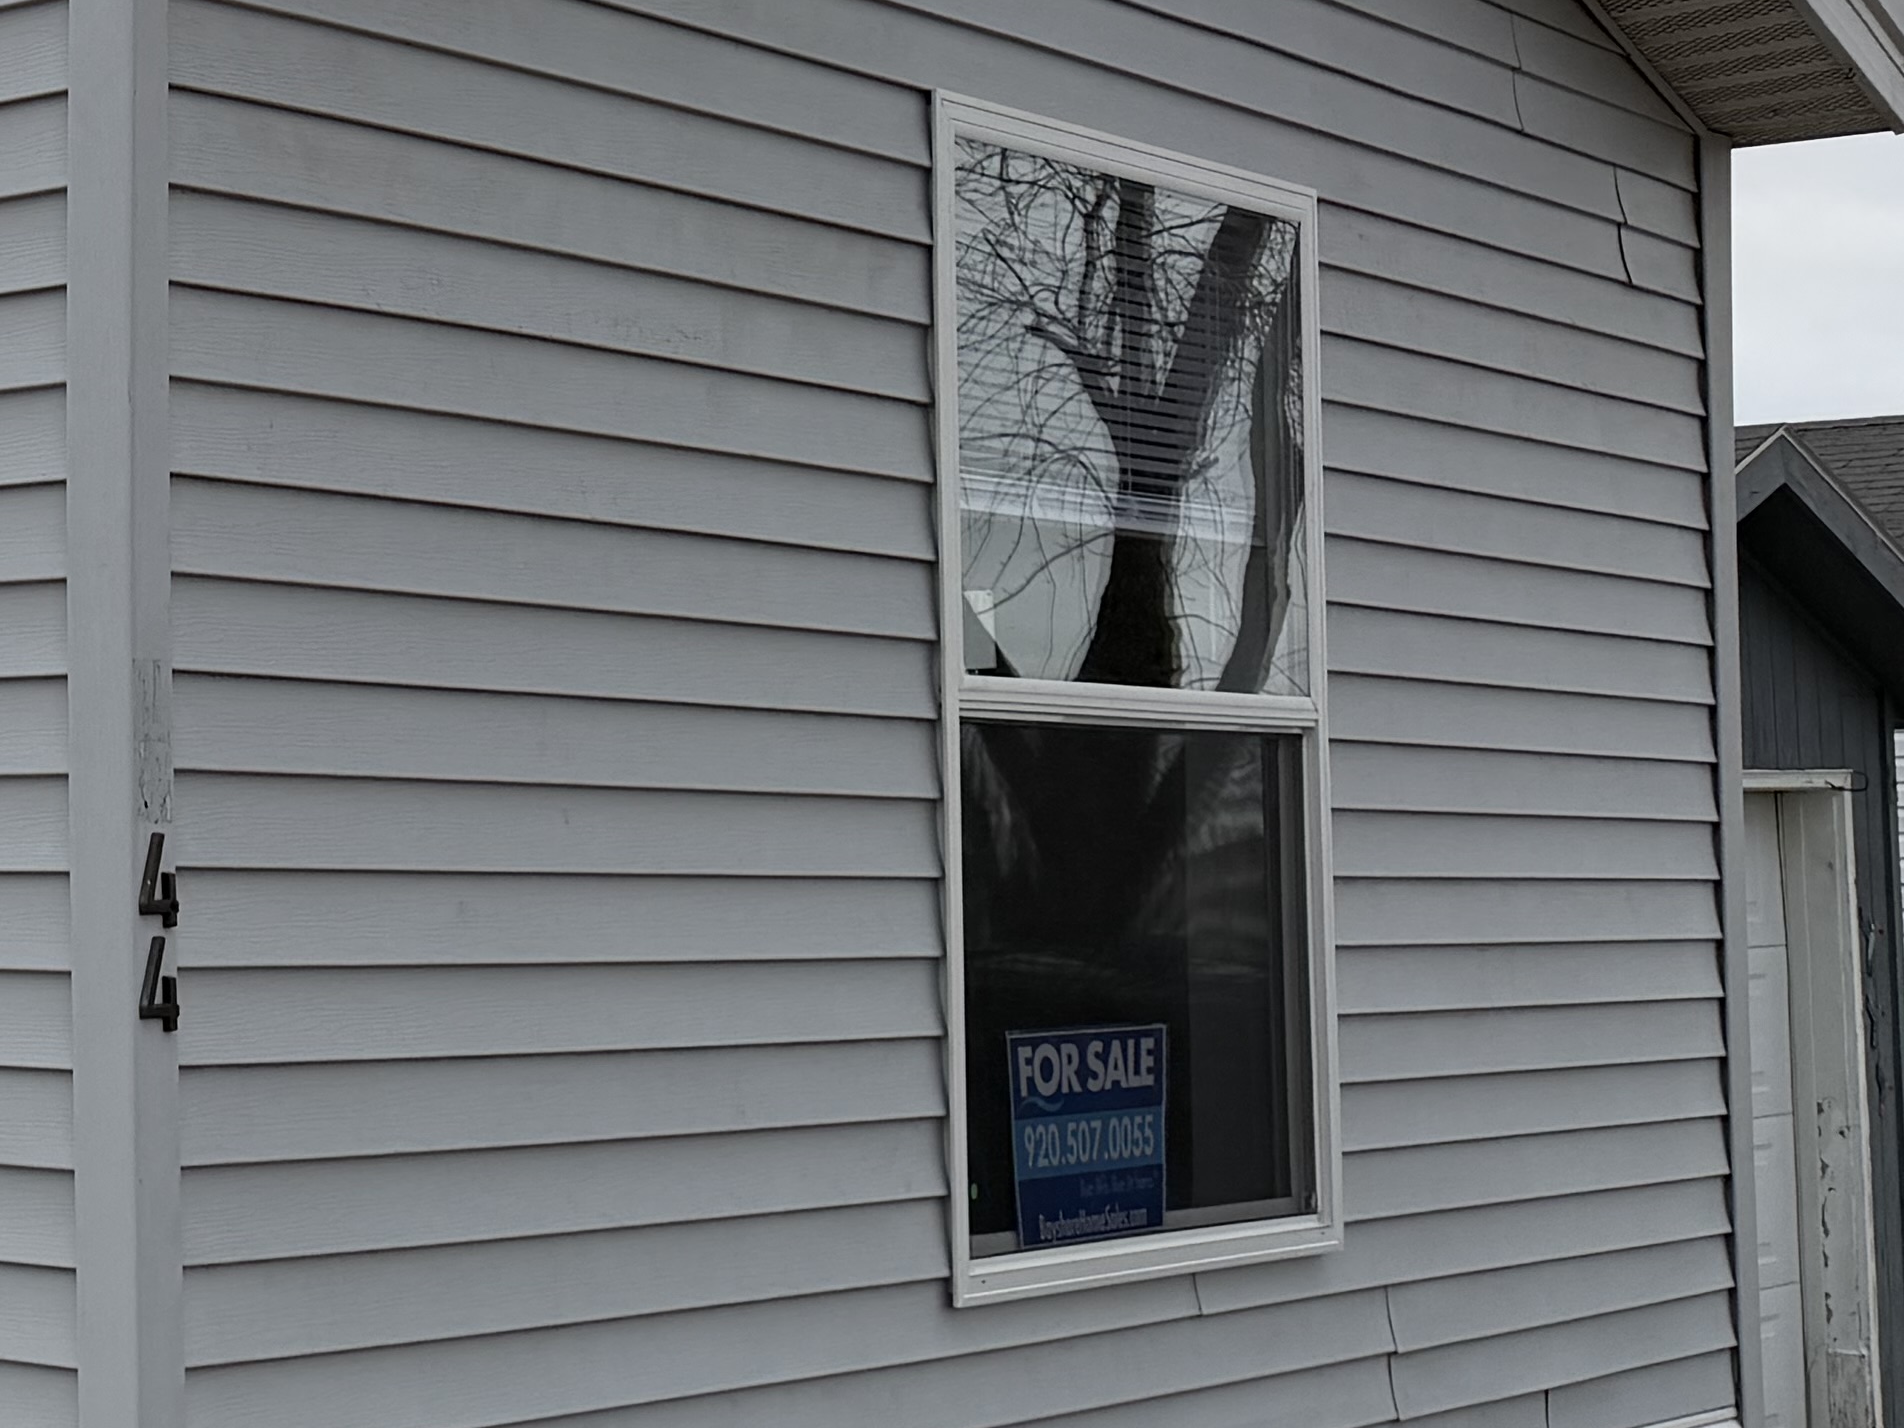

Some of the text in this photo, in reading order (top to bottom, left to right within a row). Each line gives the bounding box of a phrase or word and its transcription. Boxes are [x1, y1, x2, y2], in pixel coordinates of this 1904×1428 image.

[139, 832, 180, 1032] 44
[1017, 1037, 1155, 1097] FOR SALE
[1024, 1114, 1154, 1168] 920.507.0055
